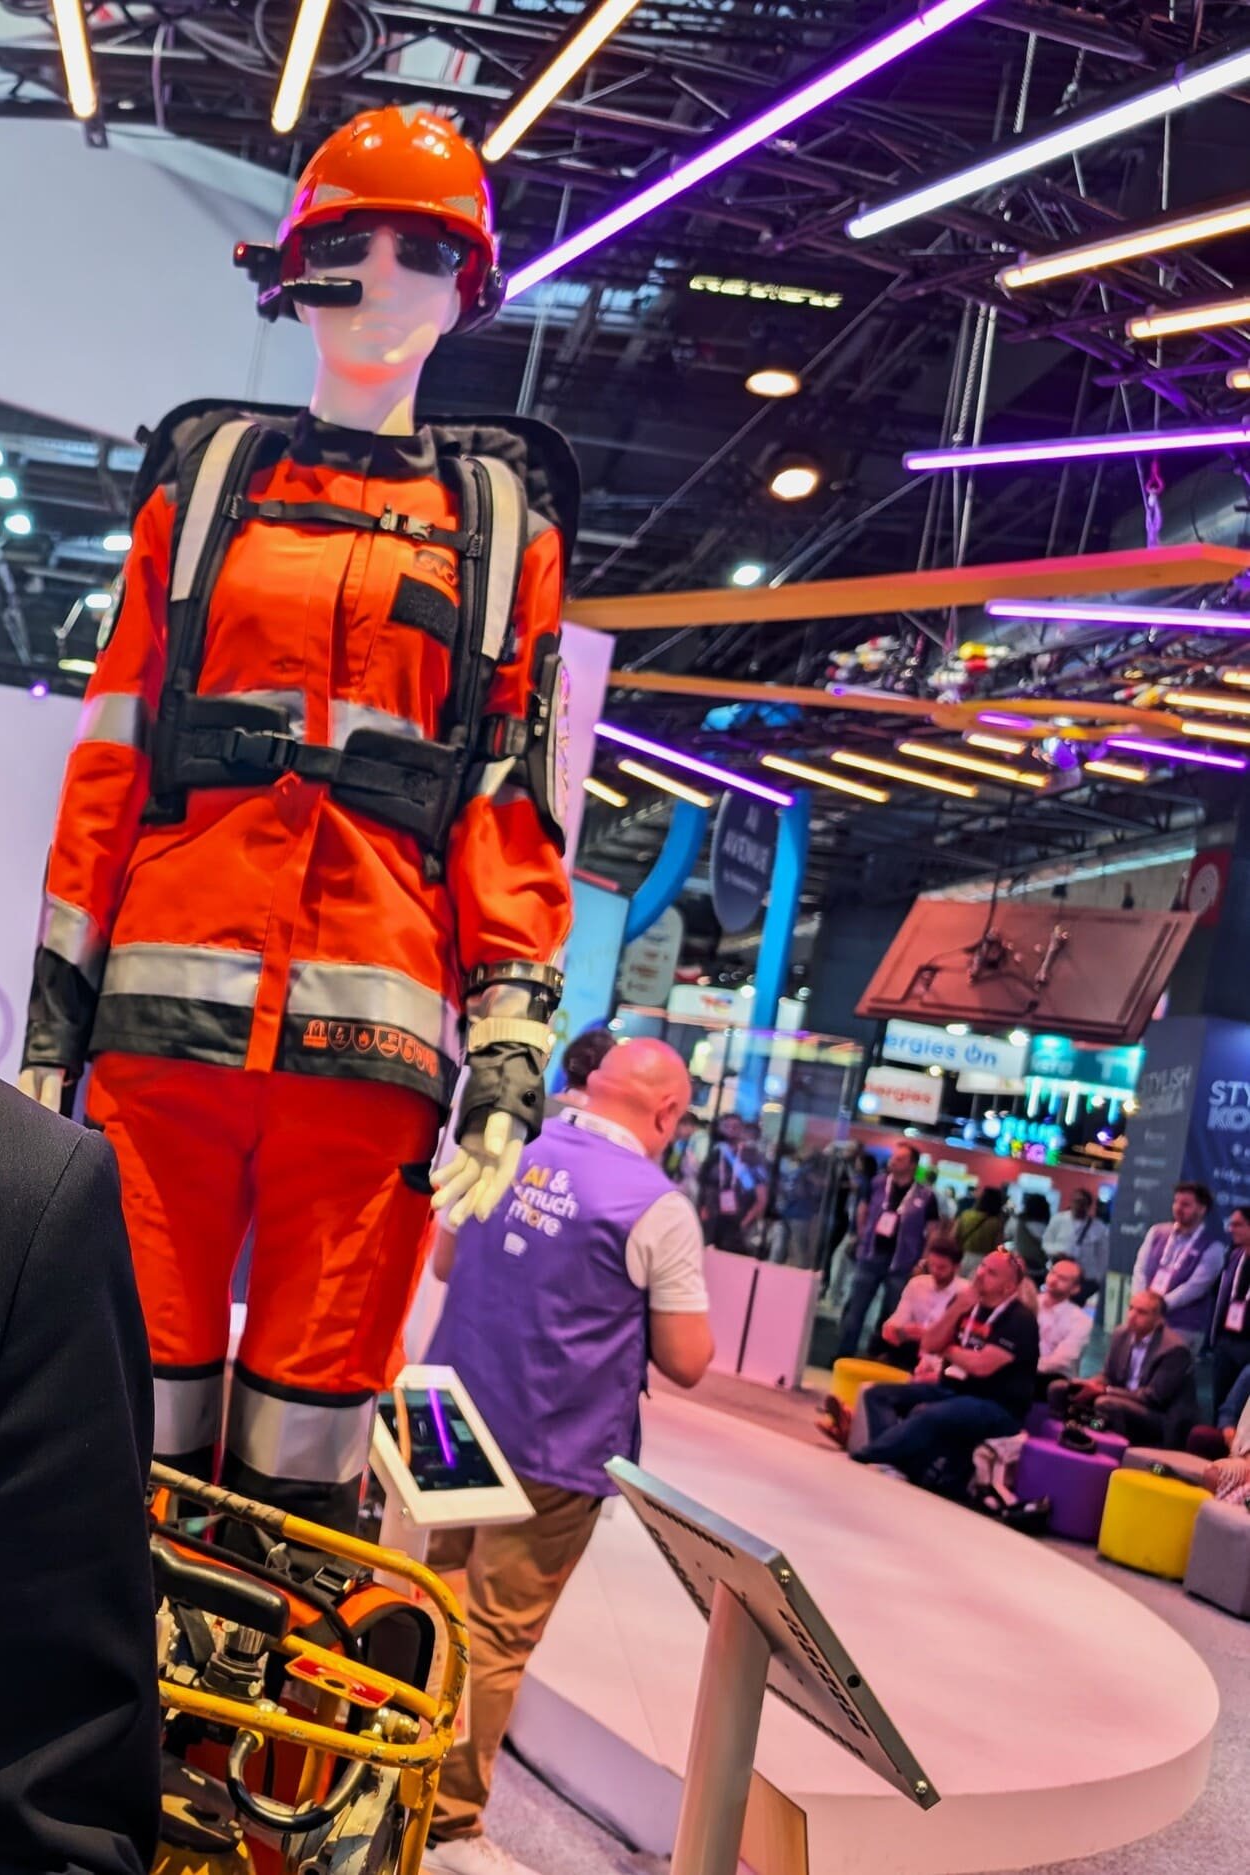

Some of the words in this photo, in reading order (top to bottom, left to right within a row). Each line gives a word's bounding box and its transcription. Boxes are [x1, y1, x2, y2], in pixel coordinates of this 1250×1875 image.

[521, 1164, 551, 1190] AI
[549, 1169, 570, 1194] &
[507, 1199, 563, 1237] more
[523, 1186, 580, 1220] much
